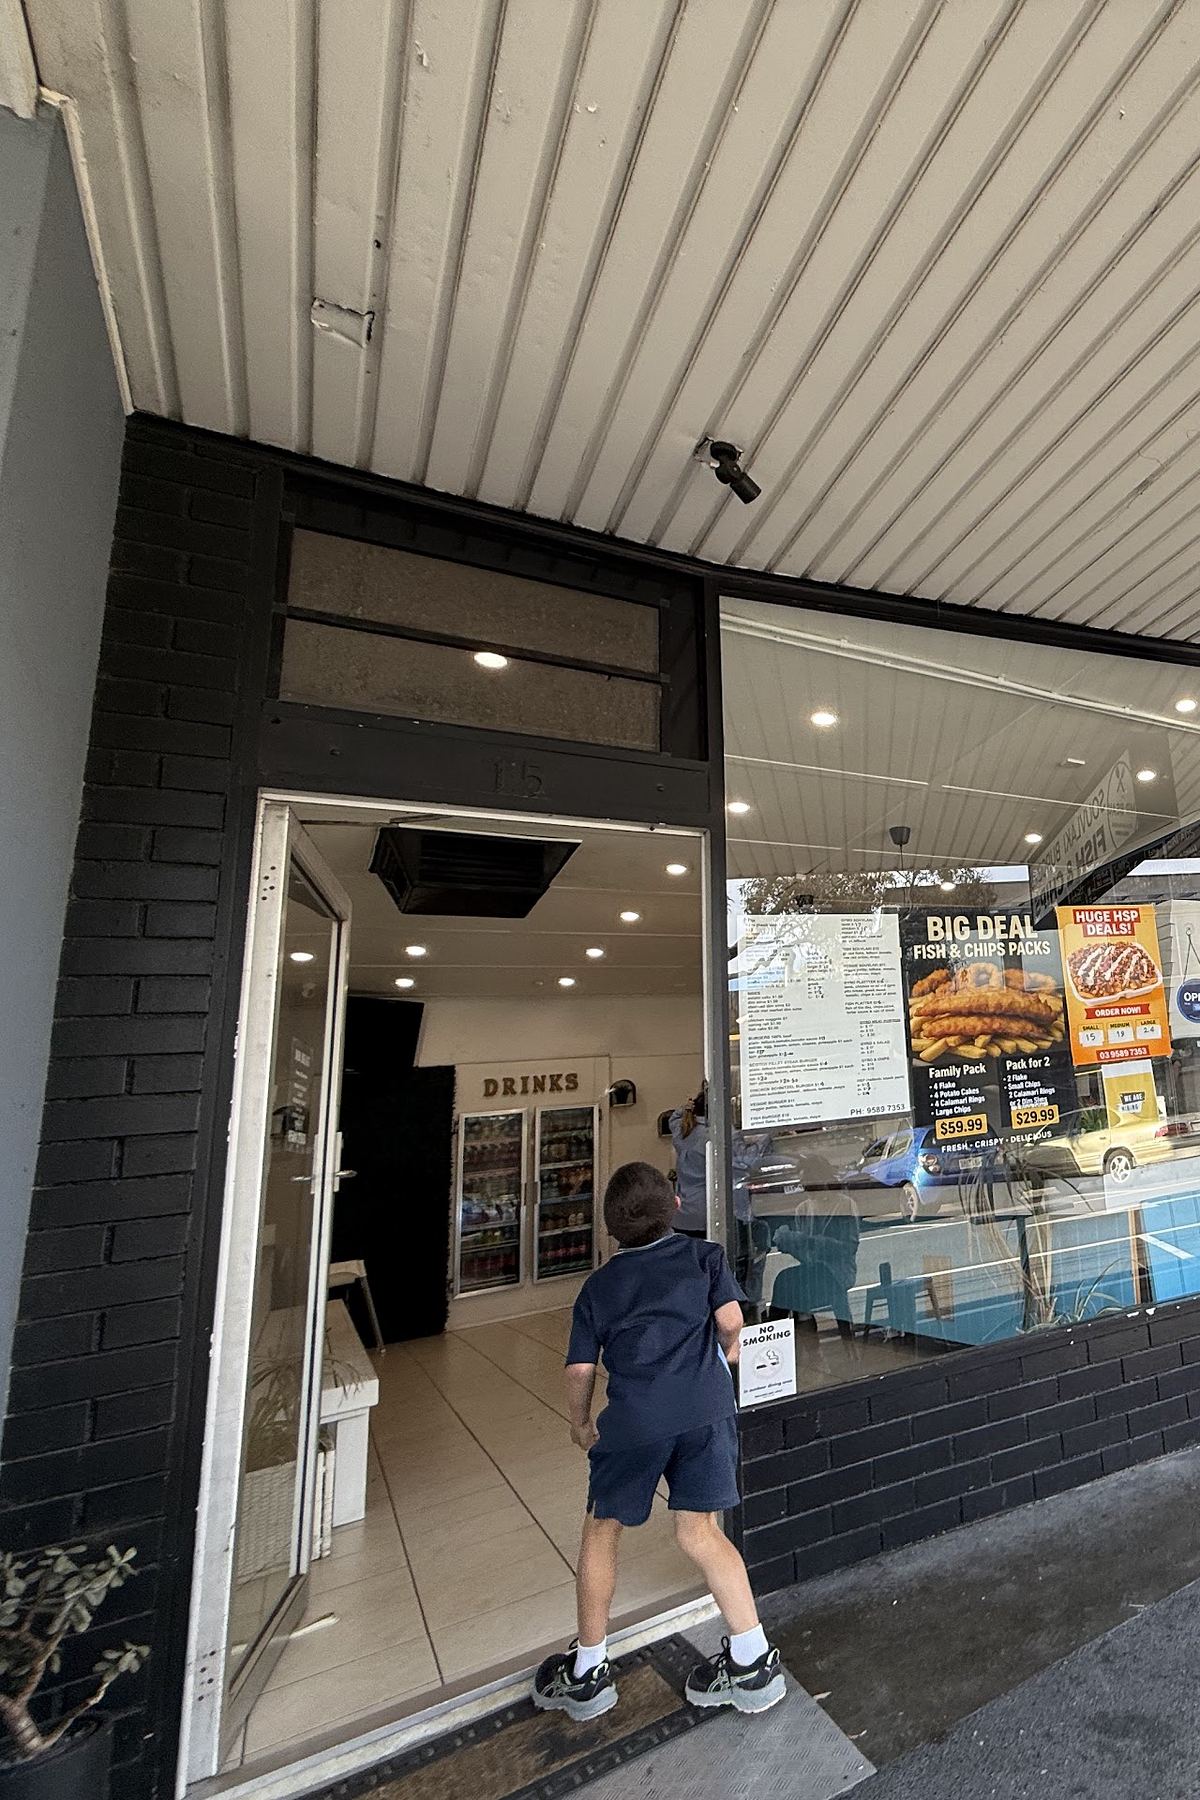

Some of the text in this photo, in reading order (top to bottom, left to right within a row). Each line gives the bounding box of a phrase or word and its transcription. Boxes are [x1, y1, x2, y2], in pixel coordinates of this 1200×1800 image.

[1076, 910, 1139, 923] HUGE HSP
[926, 915, 1038, 941] BIG DEAL
[1086, 922, 1133, 936] DEALS!
[913, 941, 1051, 960] FISH & CHIPS PACKS
[1095, 1007, 1141, 1017] ORDER NOW!
[1086, 1033, 1096, 1041] 15
[1100, 1047, 1147, 1059] 03 9589 7353
[1006, 1057, 1050, 1070] Pack for 2
[929, 1063, 987, 1078] Family Pack
[483, 1073, 579, 1098] DRINKS
[1008, 1080, 1040, 1090] Small Chips
[940, 1090, 960, 1098] Potato
[961, 1088, 980, 1096] Cakes
[1014, 1089, 1039, 1098] Calamari
[1040, 1087, 1056, 1095] Rings
[940, 1097, 968, 1106] Calamari
[968, 1096, 985, 1104] Rings
[850, 1104, 906, 1116] PH: 9589 7353
[935, 1106, 972, 1116] Large Chips
[1016, 1108, 1054, 1125] $29.99
[940, 1118, 983, 1136] $59.99
[941, 1131, 1052, 1153] FRESH CRISPY DELICIOUS
[760, 1325, 775, 1334] NO
[743, 1330, 791, 1347] SMOKING
